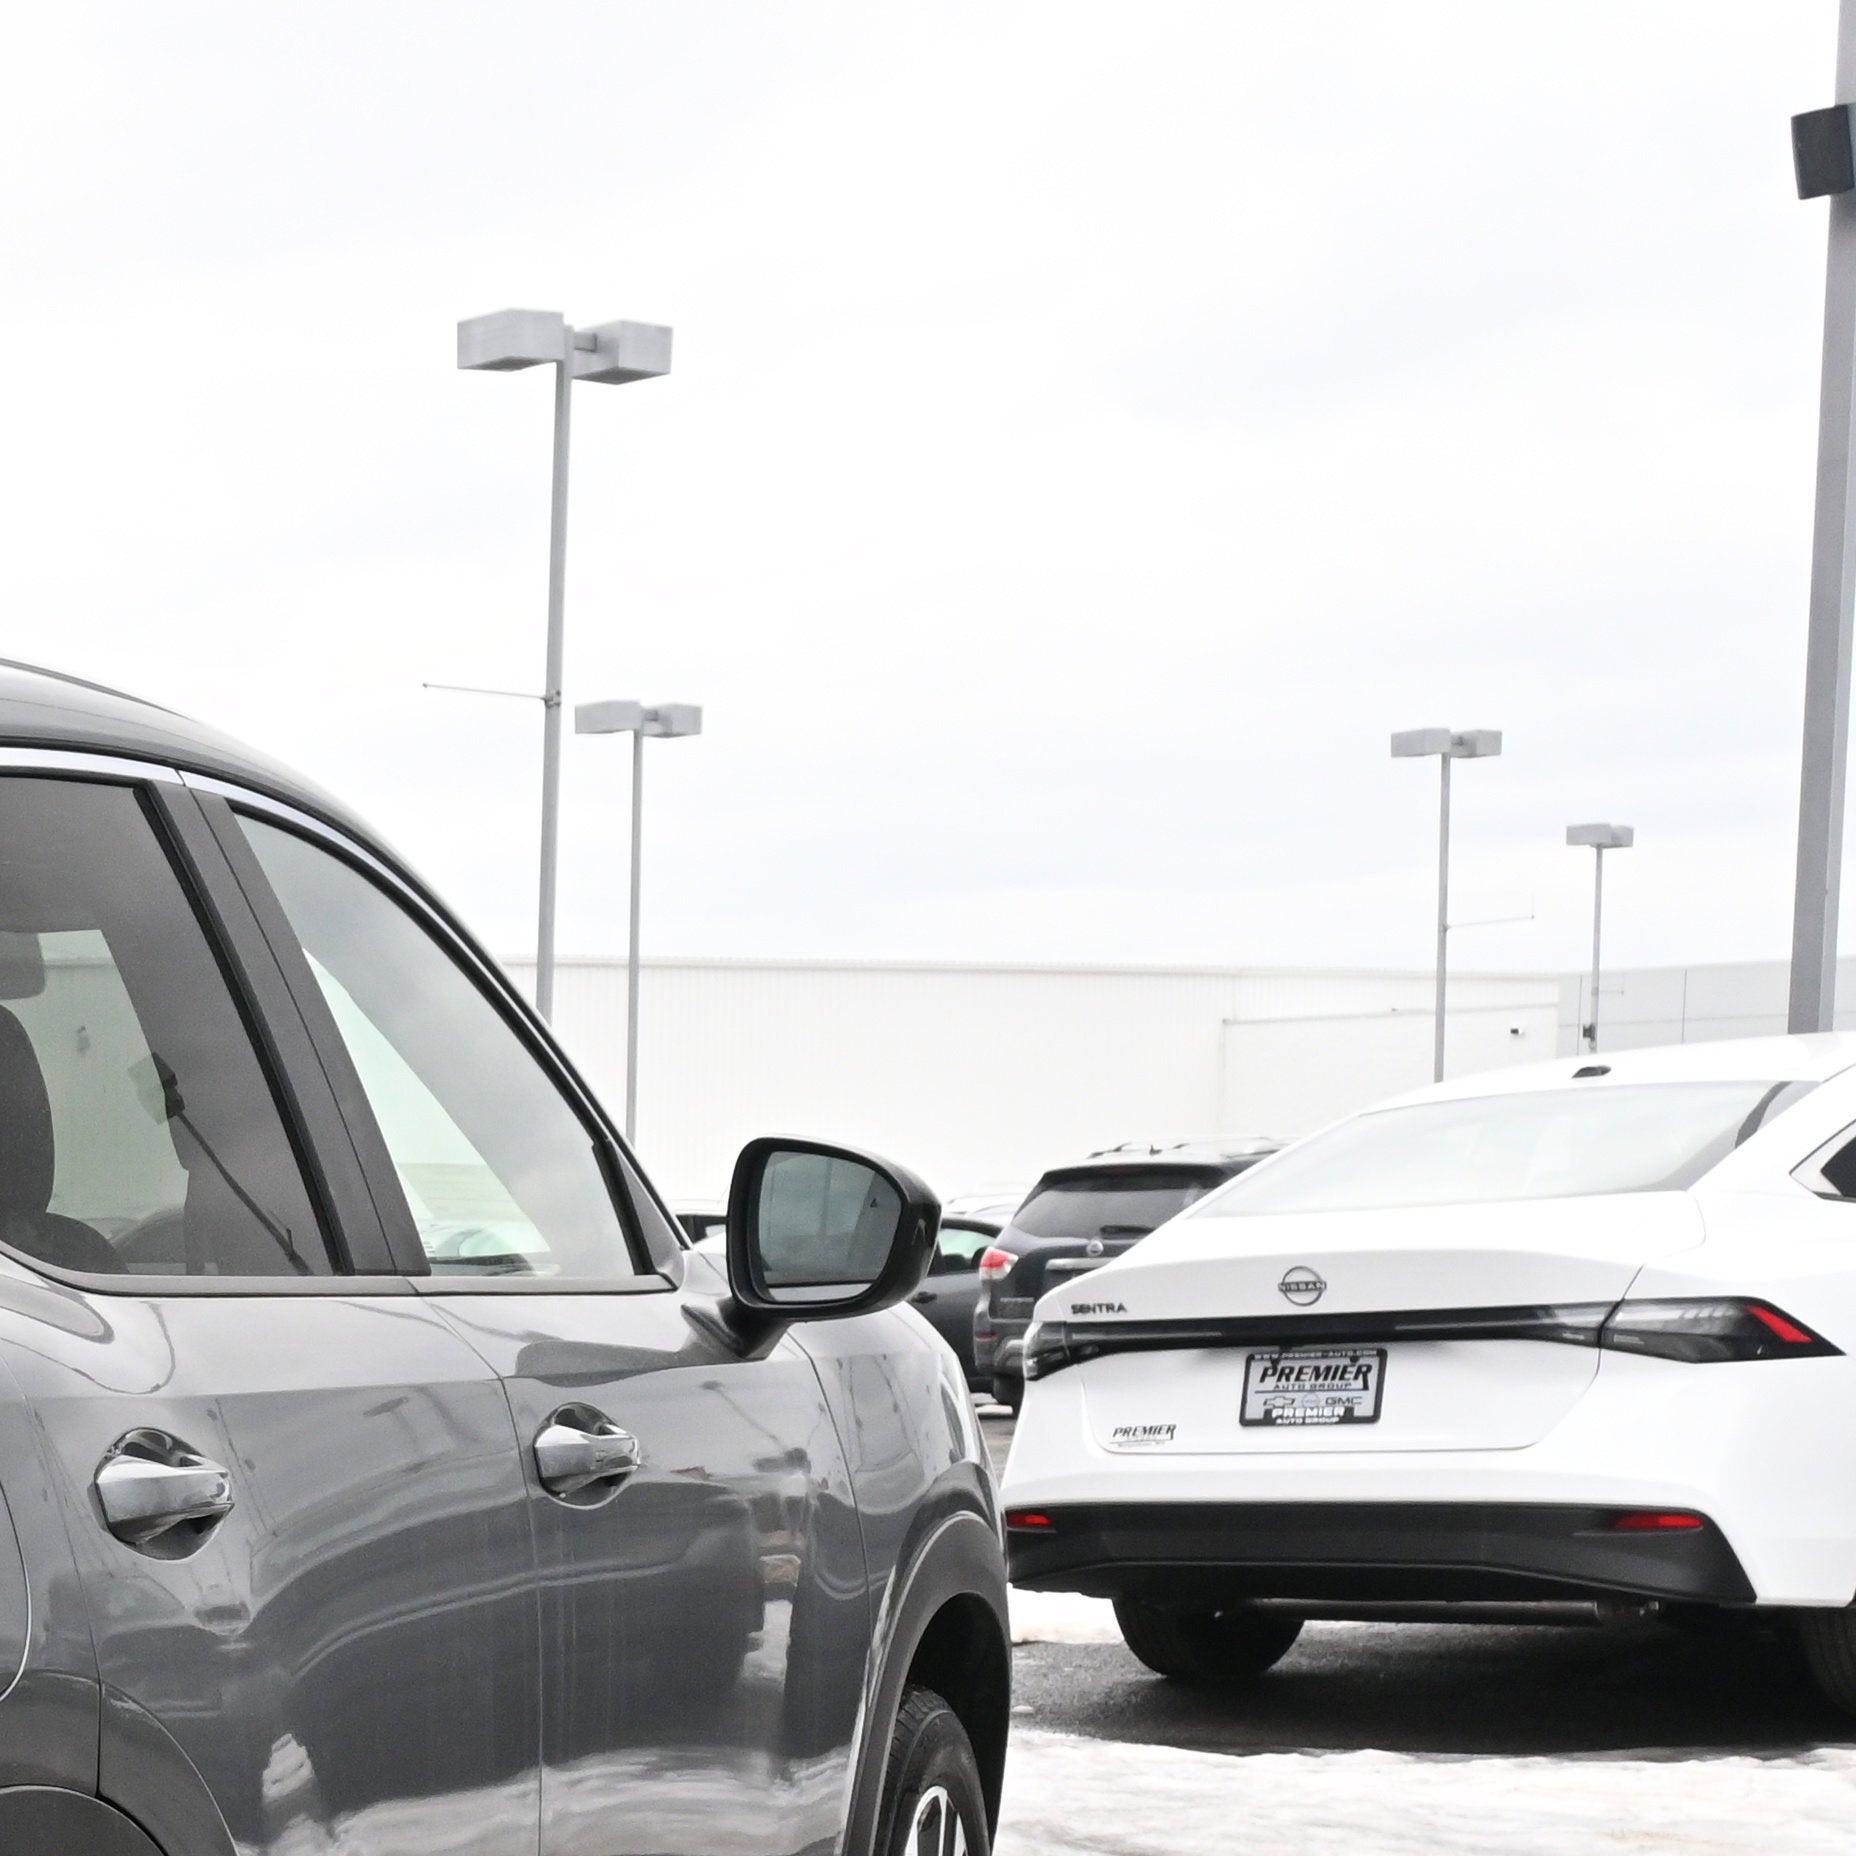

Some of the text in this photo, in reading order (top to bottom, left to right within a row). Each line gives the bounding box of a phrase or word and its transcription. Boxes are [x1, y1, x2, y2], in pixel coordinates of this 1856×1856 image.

[1278, 1281, 1326, 1292] NISSAN
[1070, 1303, 1127, 1315] SENTRA
[1259, 1363, 1373, 1386] PREMIER
[1325, 1396, 1363, 1406] GMC
[1271, 1406, 1346, 1419] PREMIER
[1111, 1423, 1177, 1439] PREMIER
